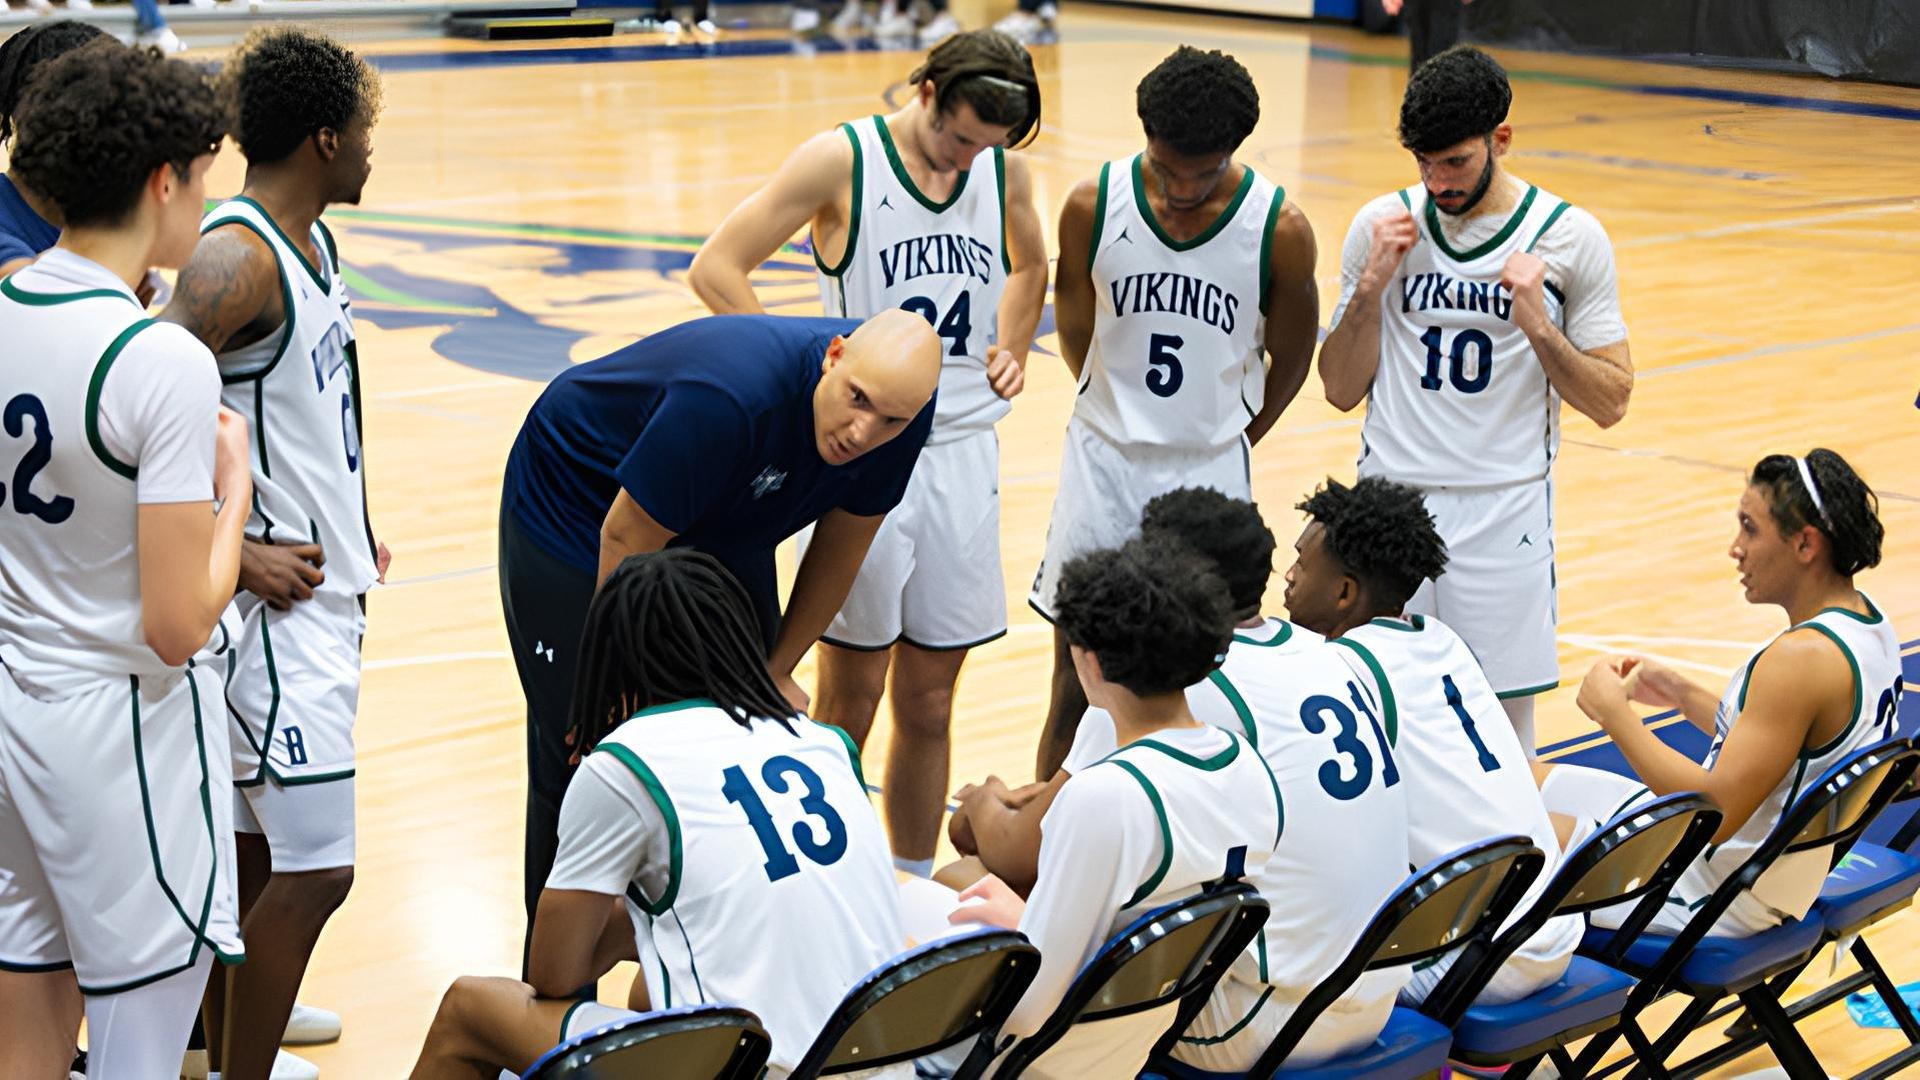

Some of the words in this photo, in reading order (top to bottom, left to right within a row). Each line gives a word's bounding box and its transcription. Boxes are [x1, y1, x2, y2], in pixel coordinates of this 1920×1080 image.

[1110, 271, 1240, 336] VIKINGS
[1401, 272, 1513, 322] VIKING
[1145, 332, 1185, 398] 5
[1419, 325, 1494, 394] 10
[0, 392, 76, 525] 2
[281, 725, 308, 766] B
[1299, 679, 1401, 801] 31
[1441, 673, 1502, 773] 1
[721, 754, 849, 883] 13
